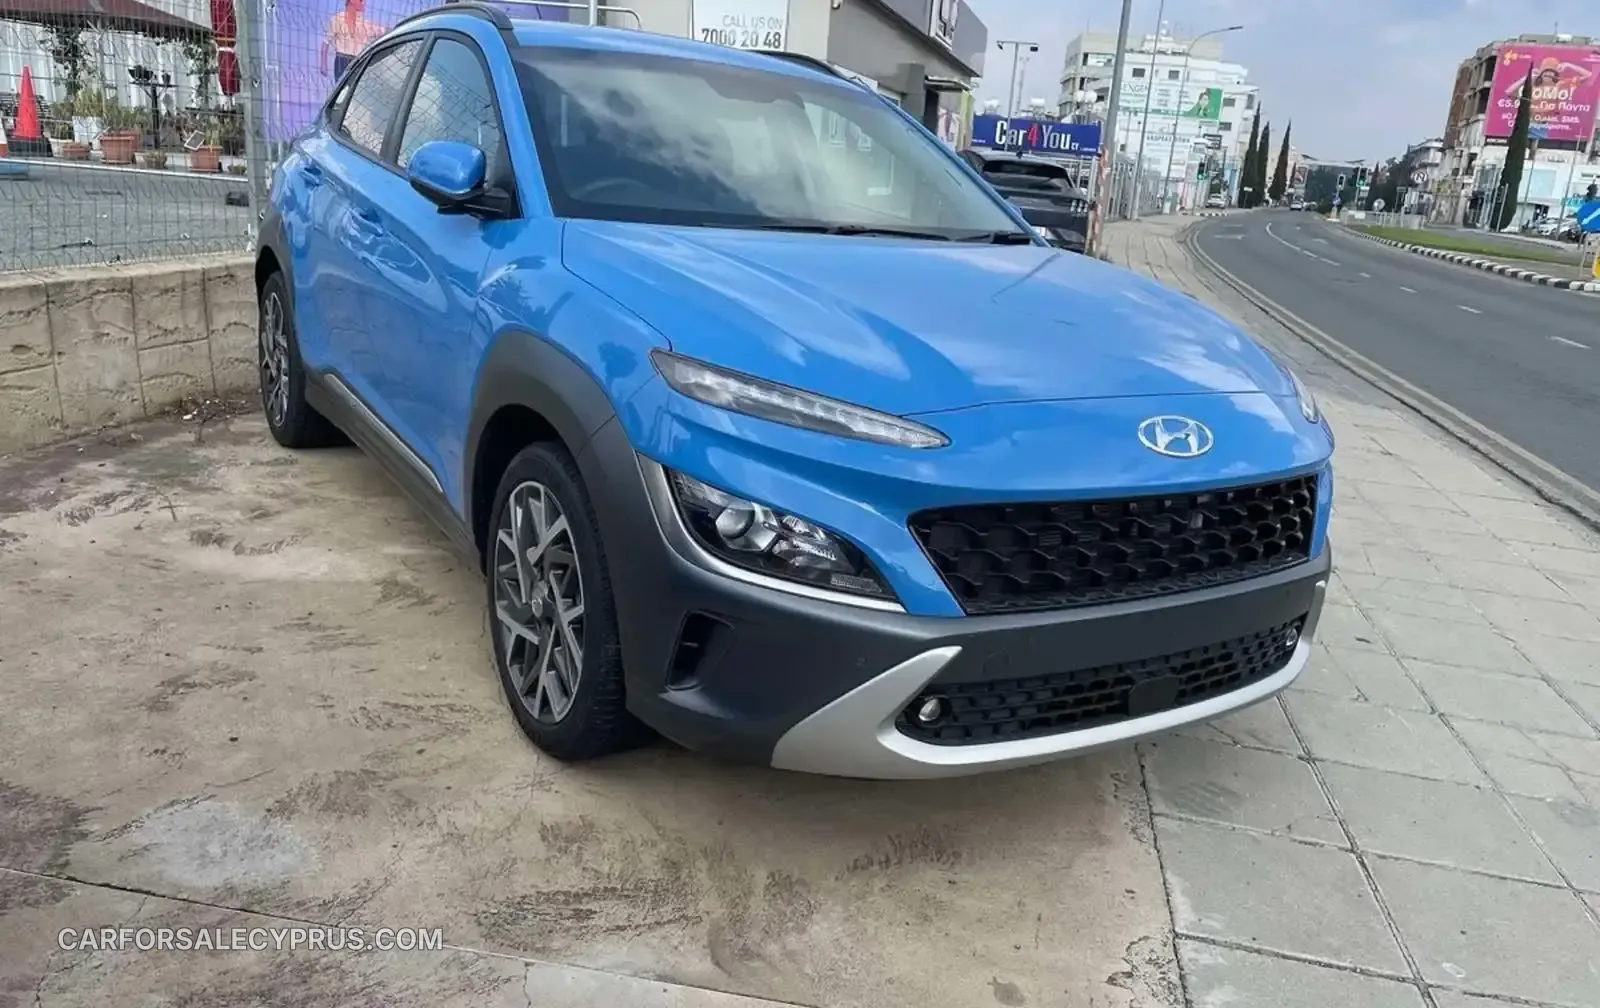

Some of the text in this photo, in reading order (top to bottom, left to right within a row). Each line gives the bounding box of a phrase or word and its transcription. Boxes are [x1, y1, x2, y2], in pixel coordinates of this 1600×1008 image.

[723, 14, 783, 30] CALL US ON
[702, 28, 782, 49] 7000 20 48
